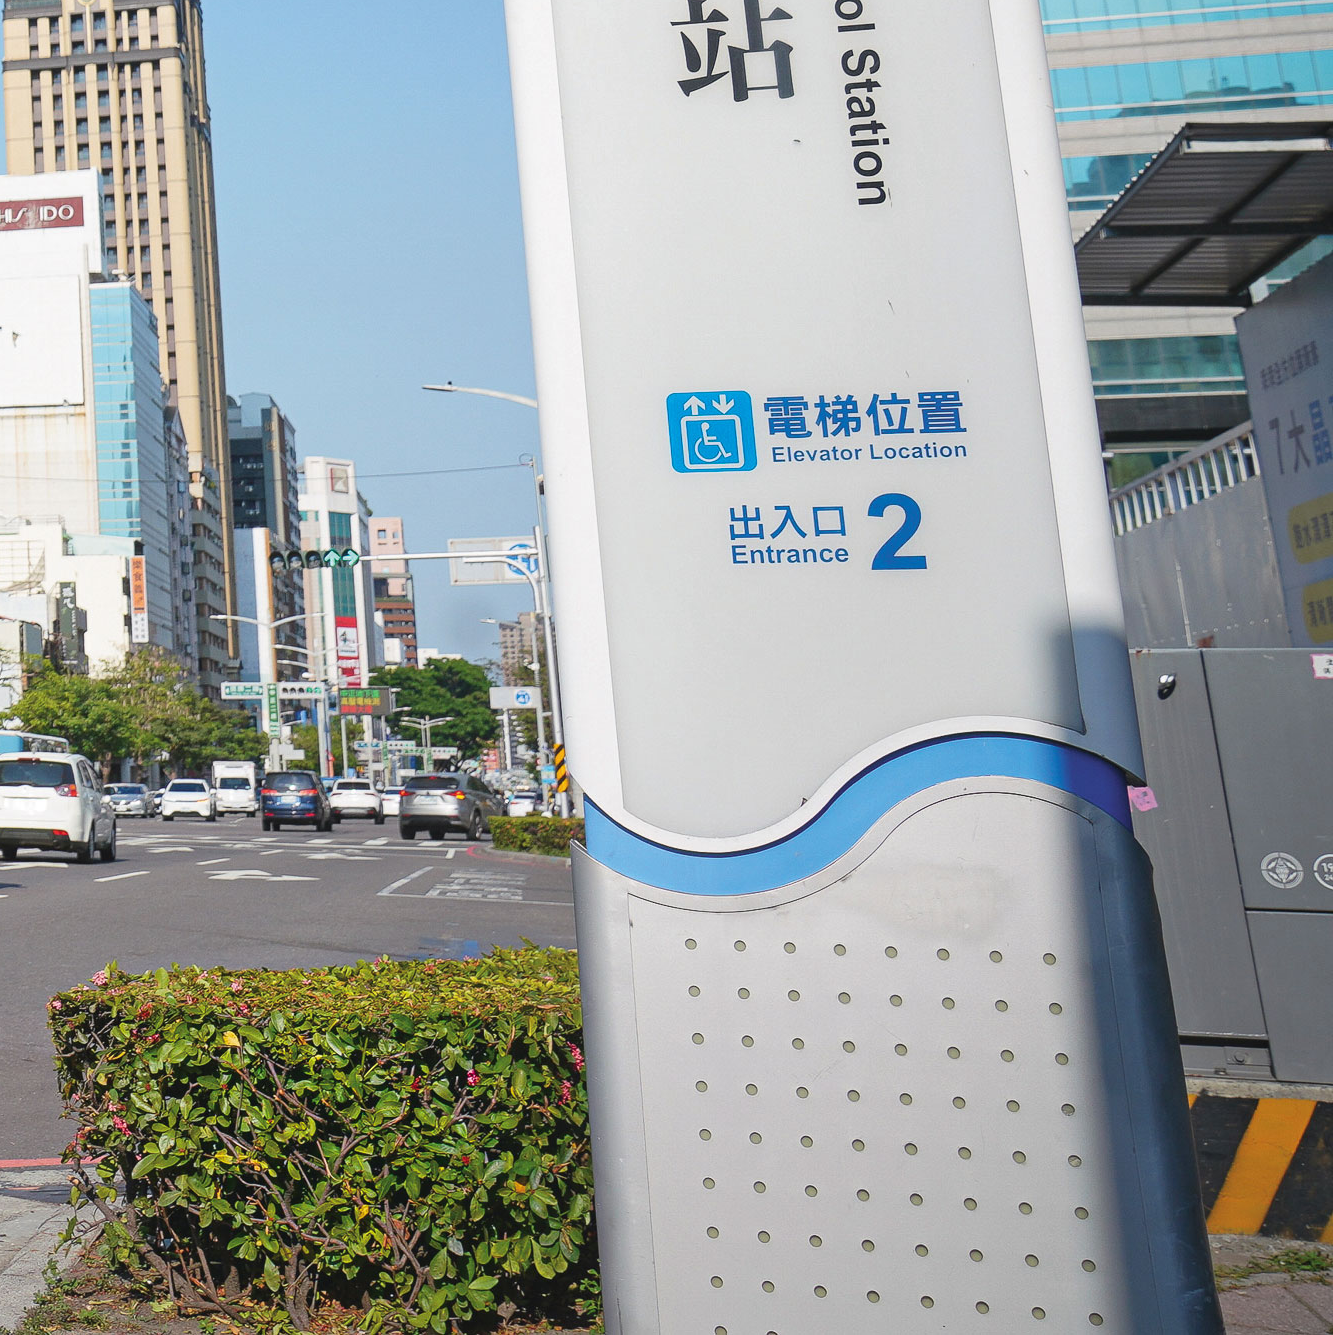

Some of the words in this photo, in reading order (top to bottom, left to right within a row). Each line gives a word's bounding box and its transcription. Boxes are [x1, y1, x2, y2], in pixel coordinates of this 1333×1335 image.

[840, 47, 892, 207] Station
[762, 390, 968, 439] 電梯位置
[771, 445, 863, 464] Elevator
[869, 441, 968, 462] Location
[728, 504, 848, 542] 出入口
[866, 492, 929, 572] 2
[731, 543, 850, 566] Entrance
